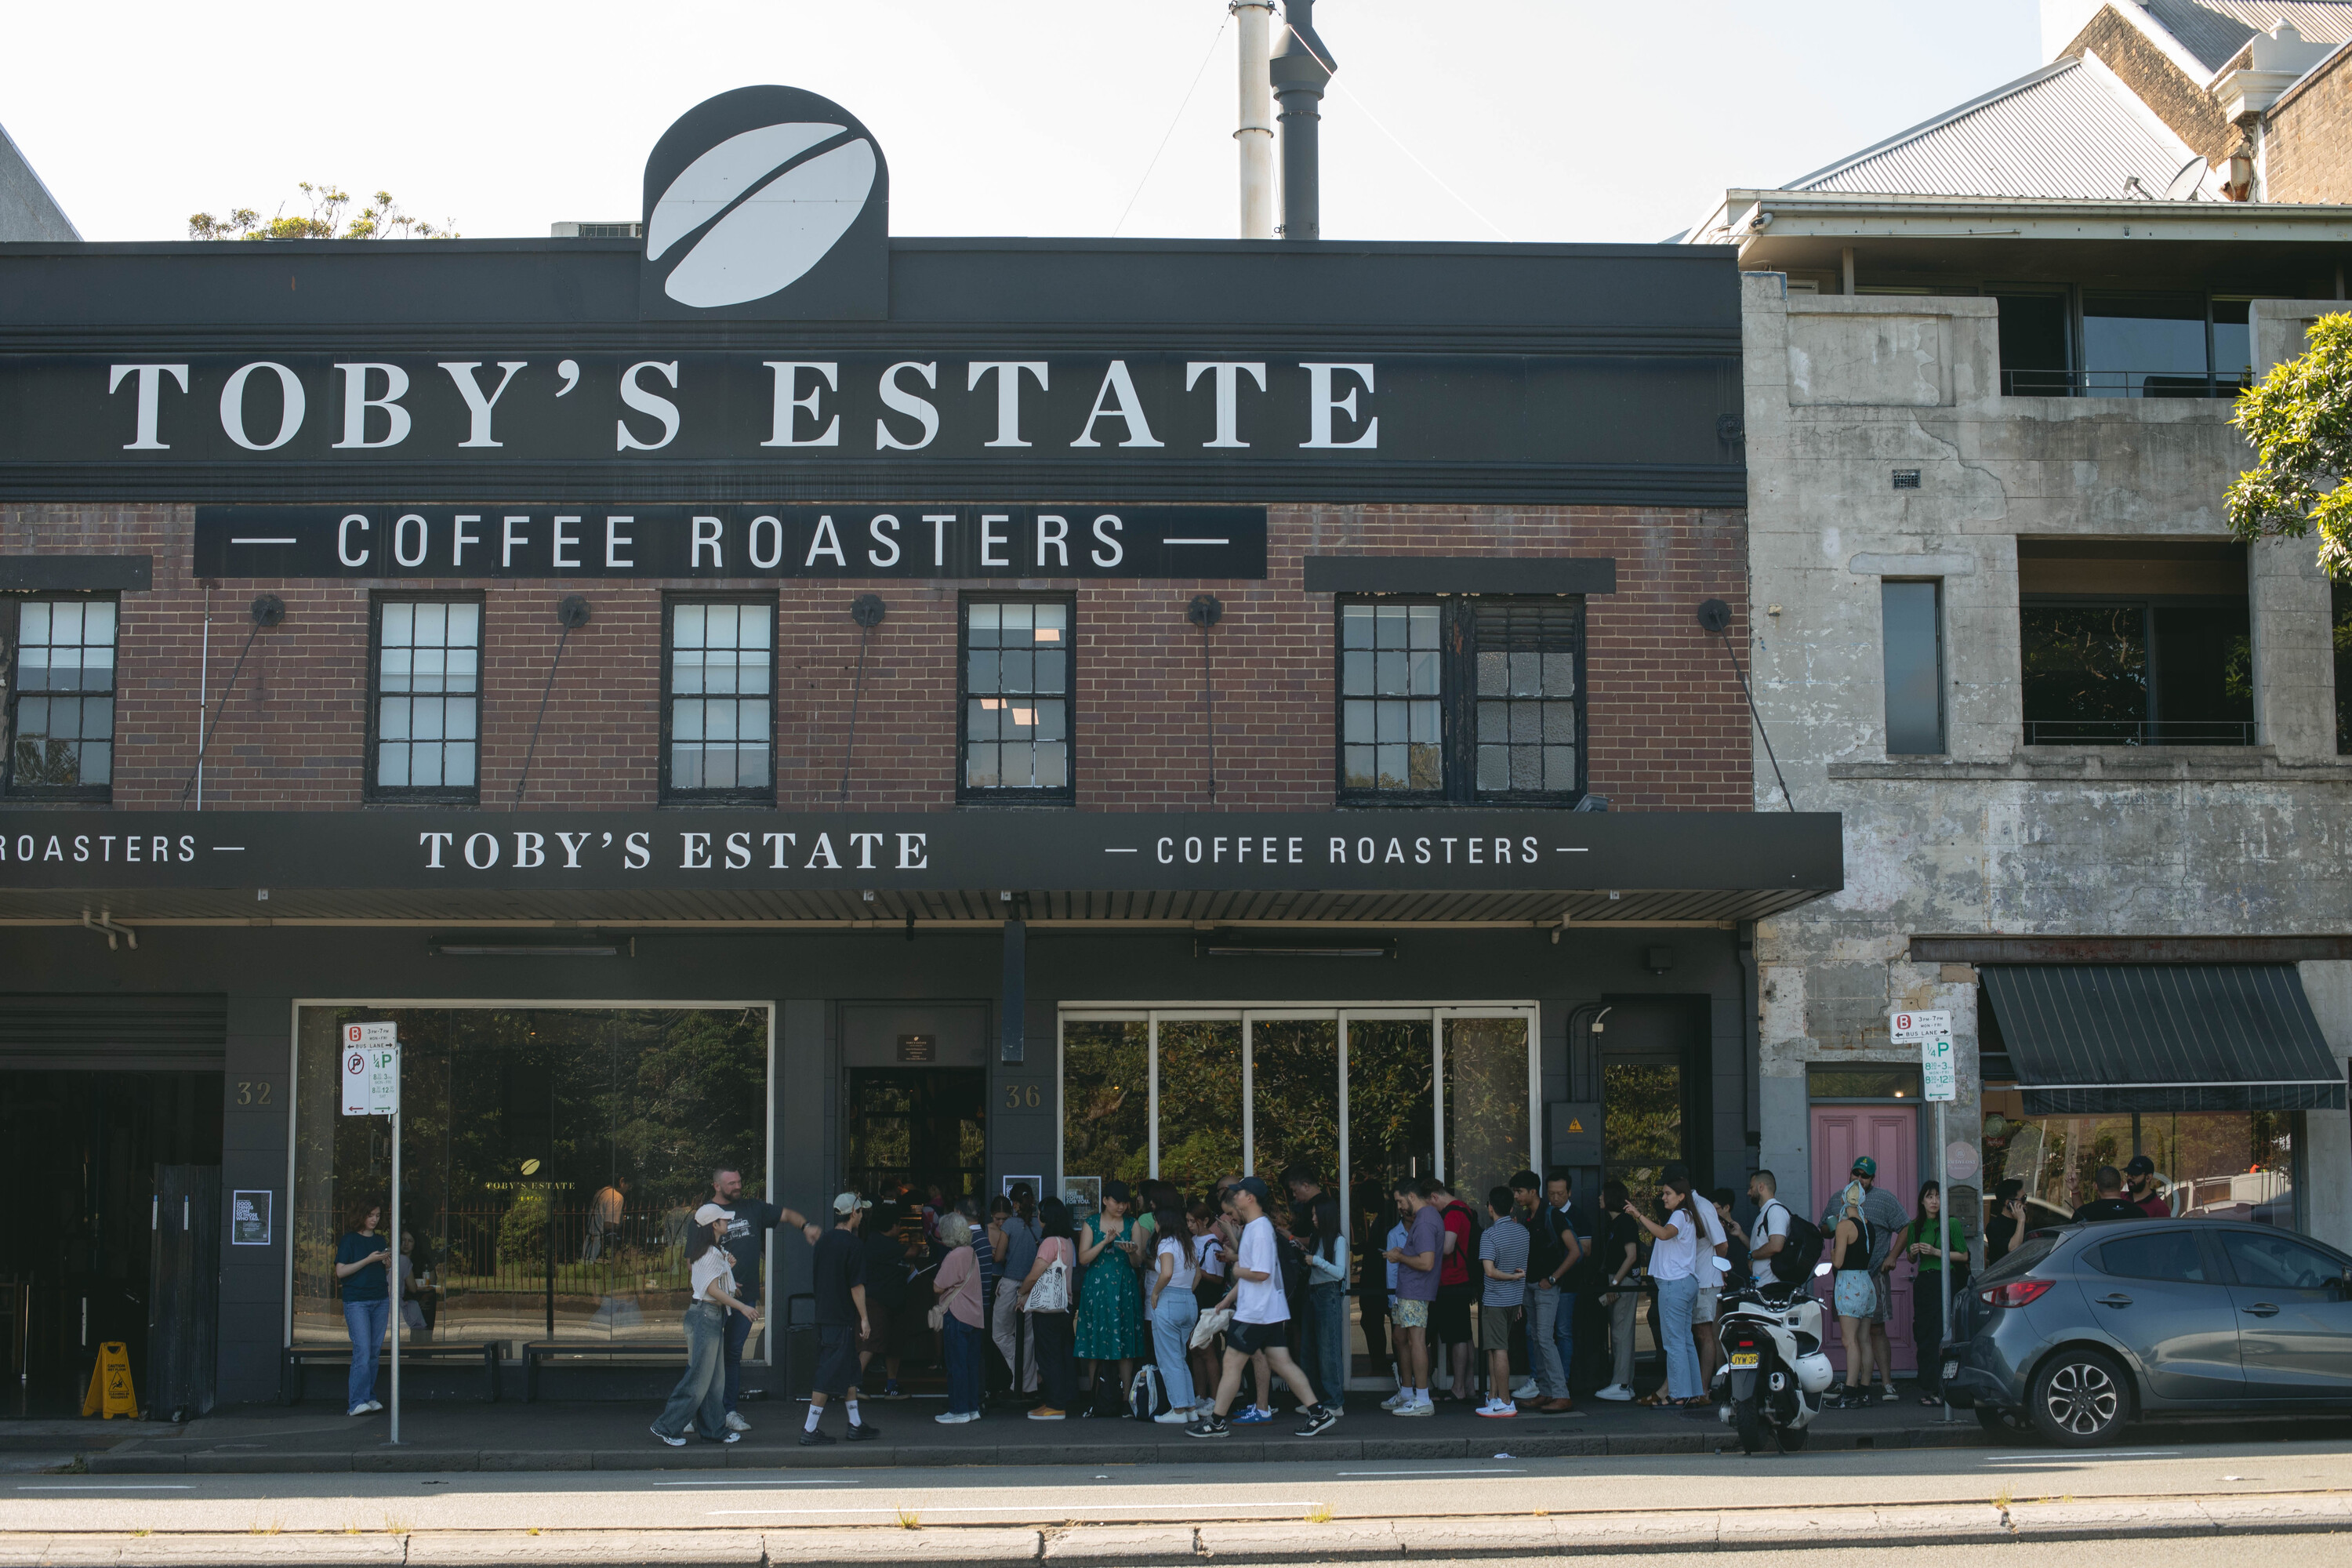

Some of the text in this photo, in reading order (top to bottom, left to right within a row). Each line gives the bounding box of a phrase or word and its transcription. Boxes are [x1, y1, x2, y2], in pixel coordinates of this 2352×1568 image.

[110, 360, 1378, 452] TOBY'S ESTATE
[338, 514, 1123, 568] COFFEE ROASTERS
[419, 832, 927, 869] TOBY'S ESTATE
[1157, 836, 1538, 864] COFFEE ROASTERS
[237, 1082, 271, 1105] 32
[1006, 1085, 1040, 1108] 36
